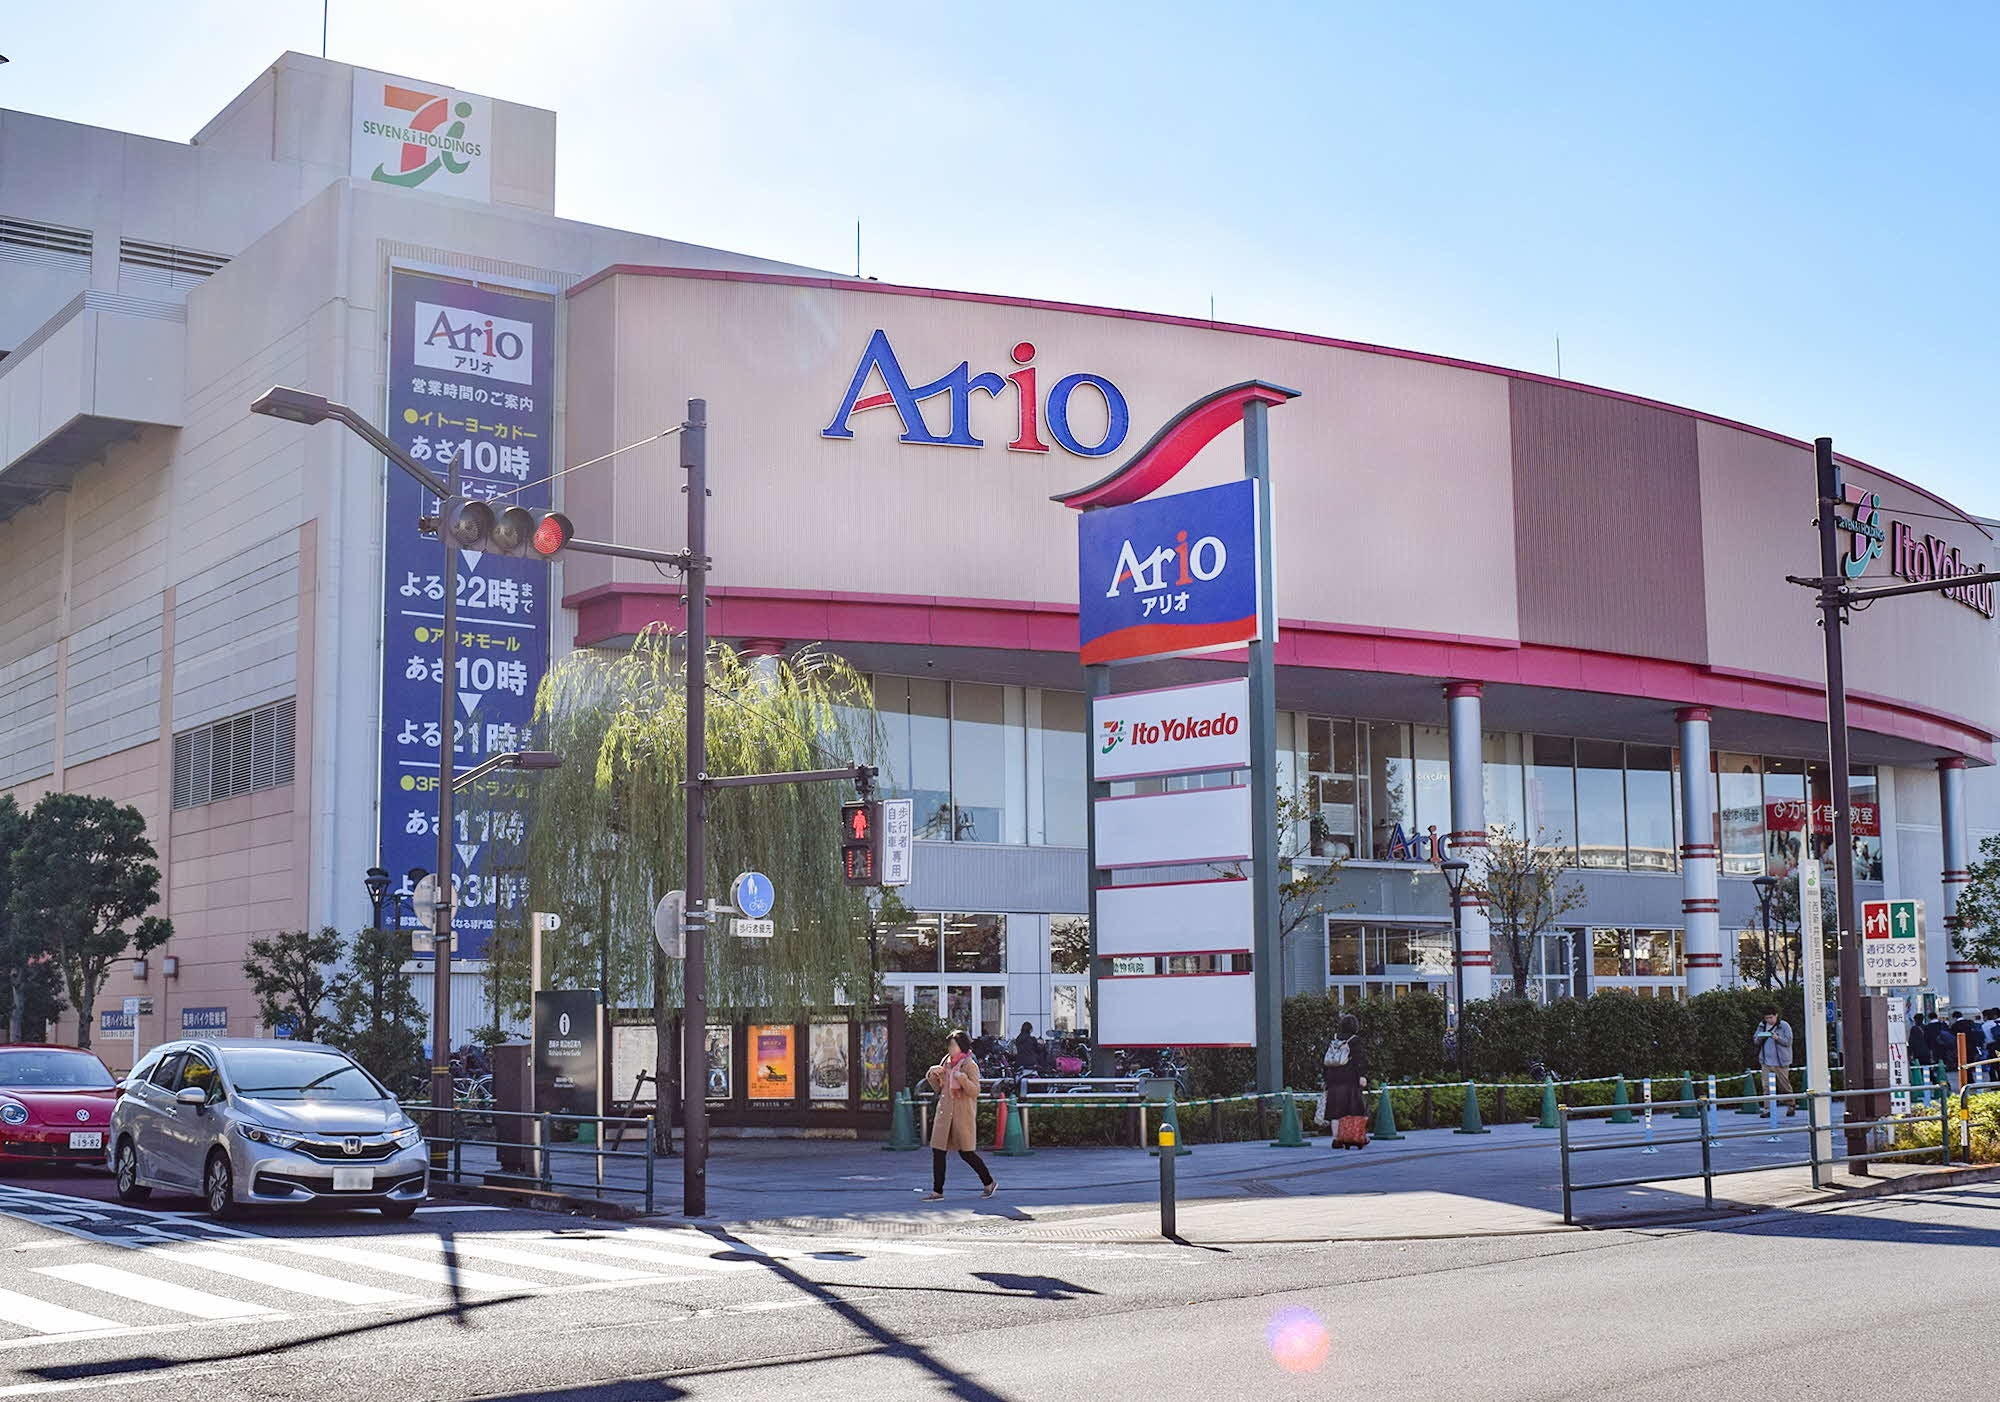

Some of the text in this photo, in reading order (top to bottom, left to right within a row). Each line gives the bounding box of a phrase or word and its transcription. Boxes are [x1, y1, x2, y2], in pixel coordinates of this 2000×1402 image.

[419, 133, 482, 157] HOLDINGS
[424, 310, 523, 361] Ario
[453, 355, 494, 375] アリオ
[411, 377, 534, 413] 営業時間のご案内
[820, 327, 1131, 459] Ario
[419, 411, 538, 441] イトーヨーカドー
[1105, 529, 1228, 598] Ario
[1141, 591, 1190, 618] アリオ
[429, 627, 521, 652] アオモール
[887, 807, 897, 848] 自転車
[898, 806, 908, 848] 歩行者
[891, 850, 903, 877] 専用
[738, 922, 772, 935] 歩行者優先
[1866, 943, 1917, 955] 通行区分を
[1866, 956, 1918, 968] 守りましょう
